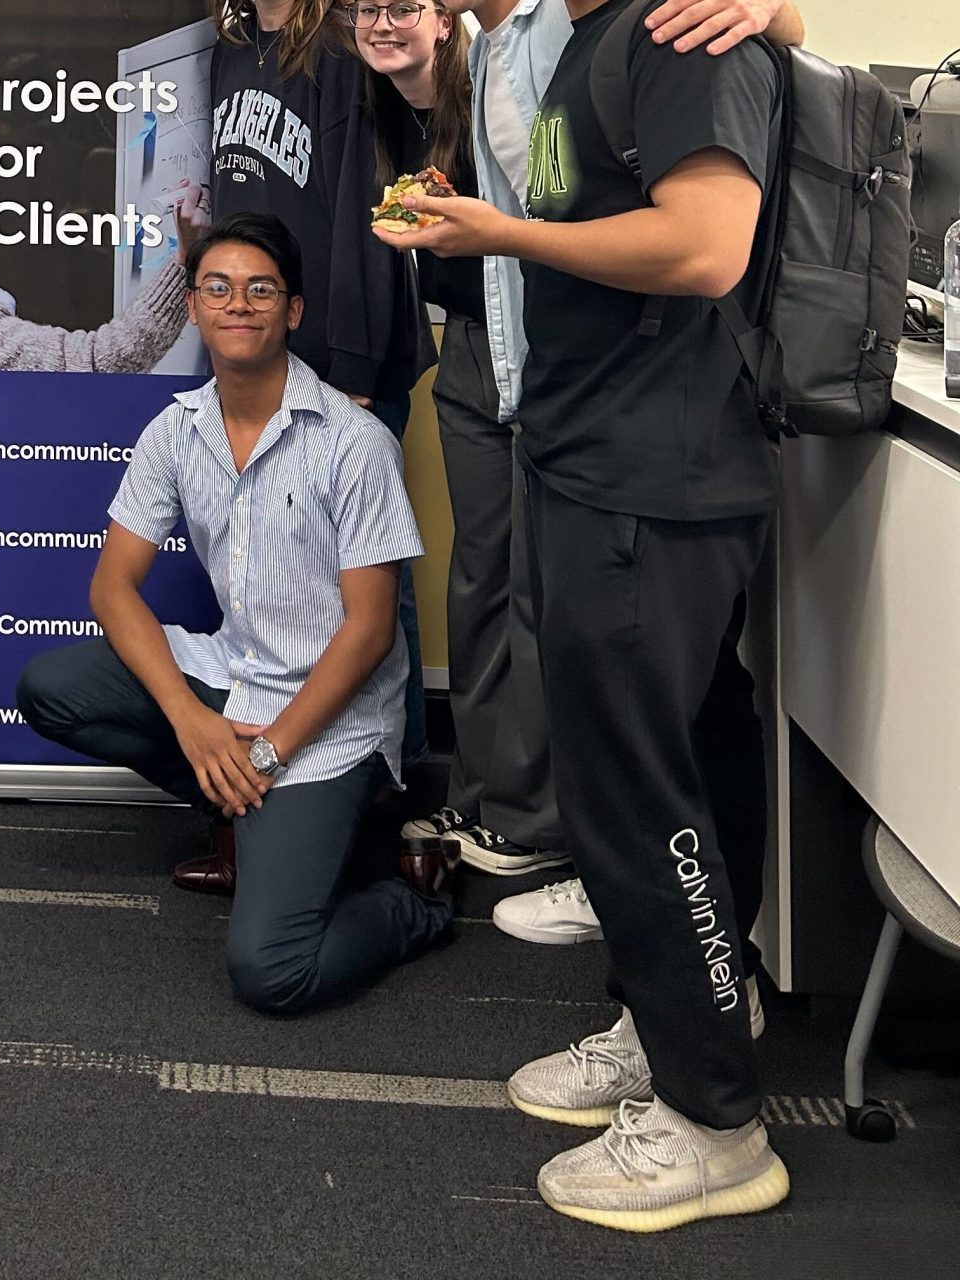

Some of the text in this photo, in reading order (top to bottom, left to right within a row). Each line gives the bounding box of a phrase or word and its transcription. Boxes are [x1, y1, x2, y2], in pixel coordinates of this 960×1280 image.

[219, 89, 312, 188] ANGELES
[669, 828, 739, 1012] Calvin Klein
